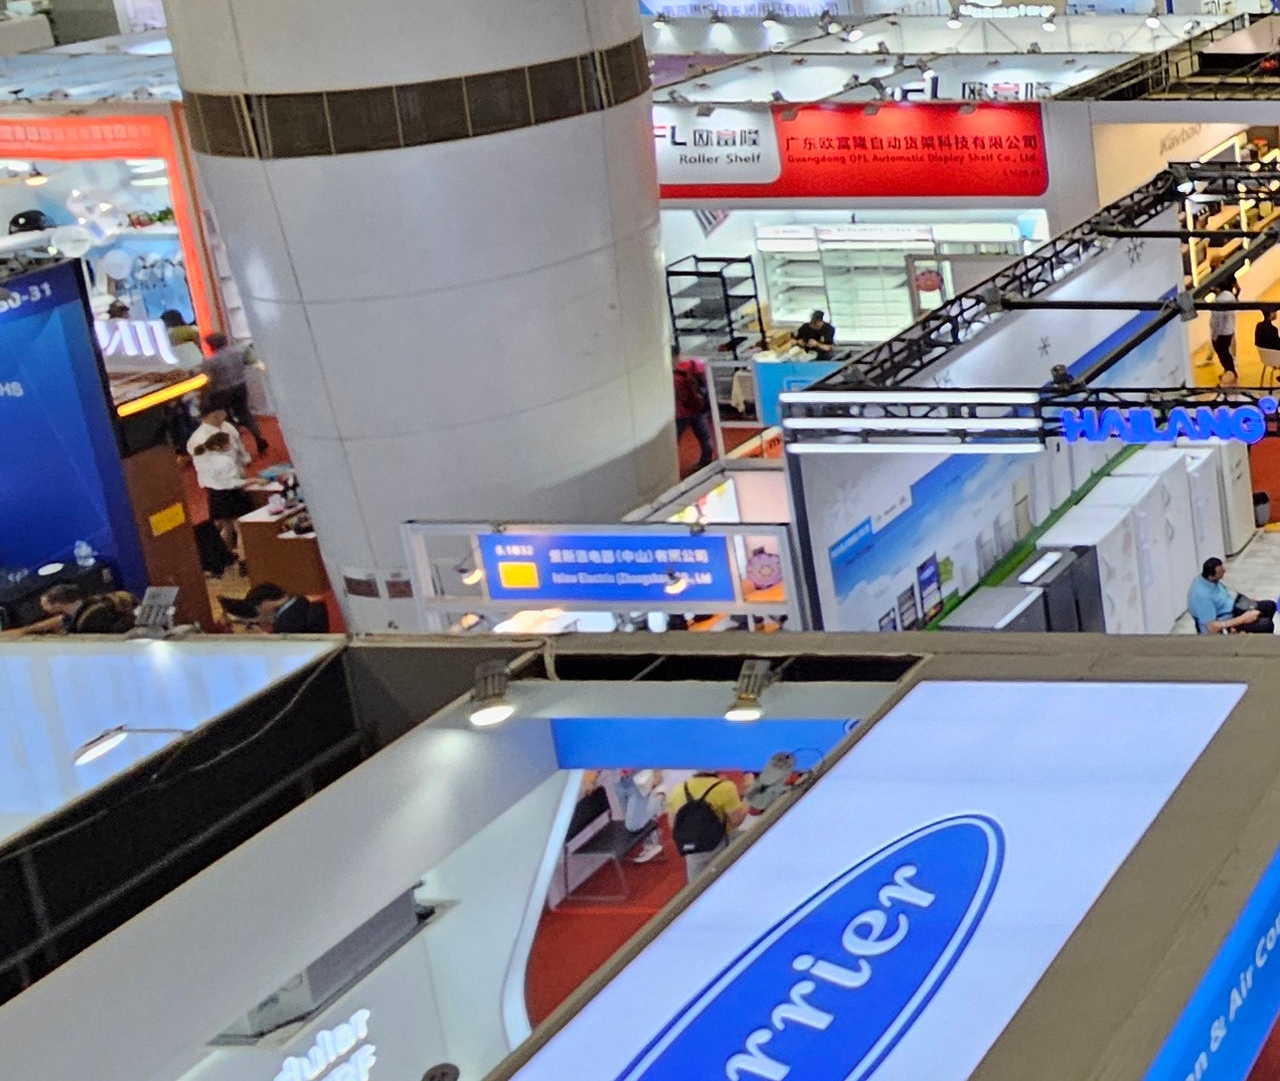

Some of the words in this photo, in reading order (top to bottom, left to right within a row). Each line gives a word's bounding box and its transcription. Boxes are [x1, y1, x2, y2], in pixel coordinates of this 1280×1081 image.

[679, 154, 719, 165] Roller
[725, 154, 762, 165] Shelf
[787, 155, 846, 166] Guangdong
[872, 154, 924, 164] Automatic
[928, 153, 965, 165] Display
[968, 153, 994, 163] Shelf
[1060, 405, 1267, 446] HAILANG
[1210, 1016, 1227, 1053] &
[1229, 964, 1255, 1023] Air
